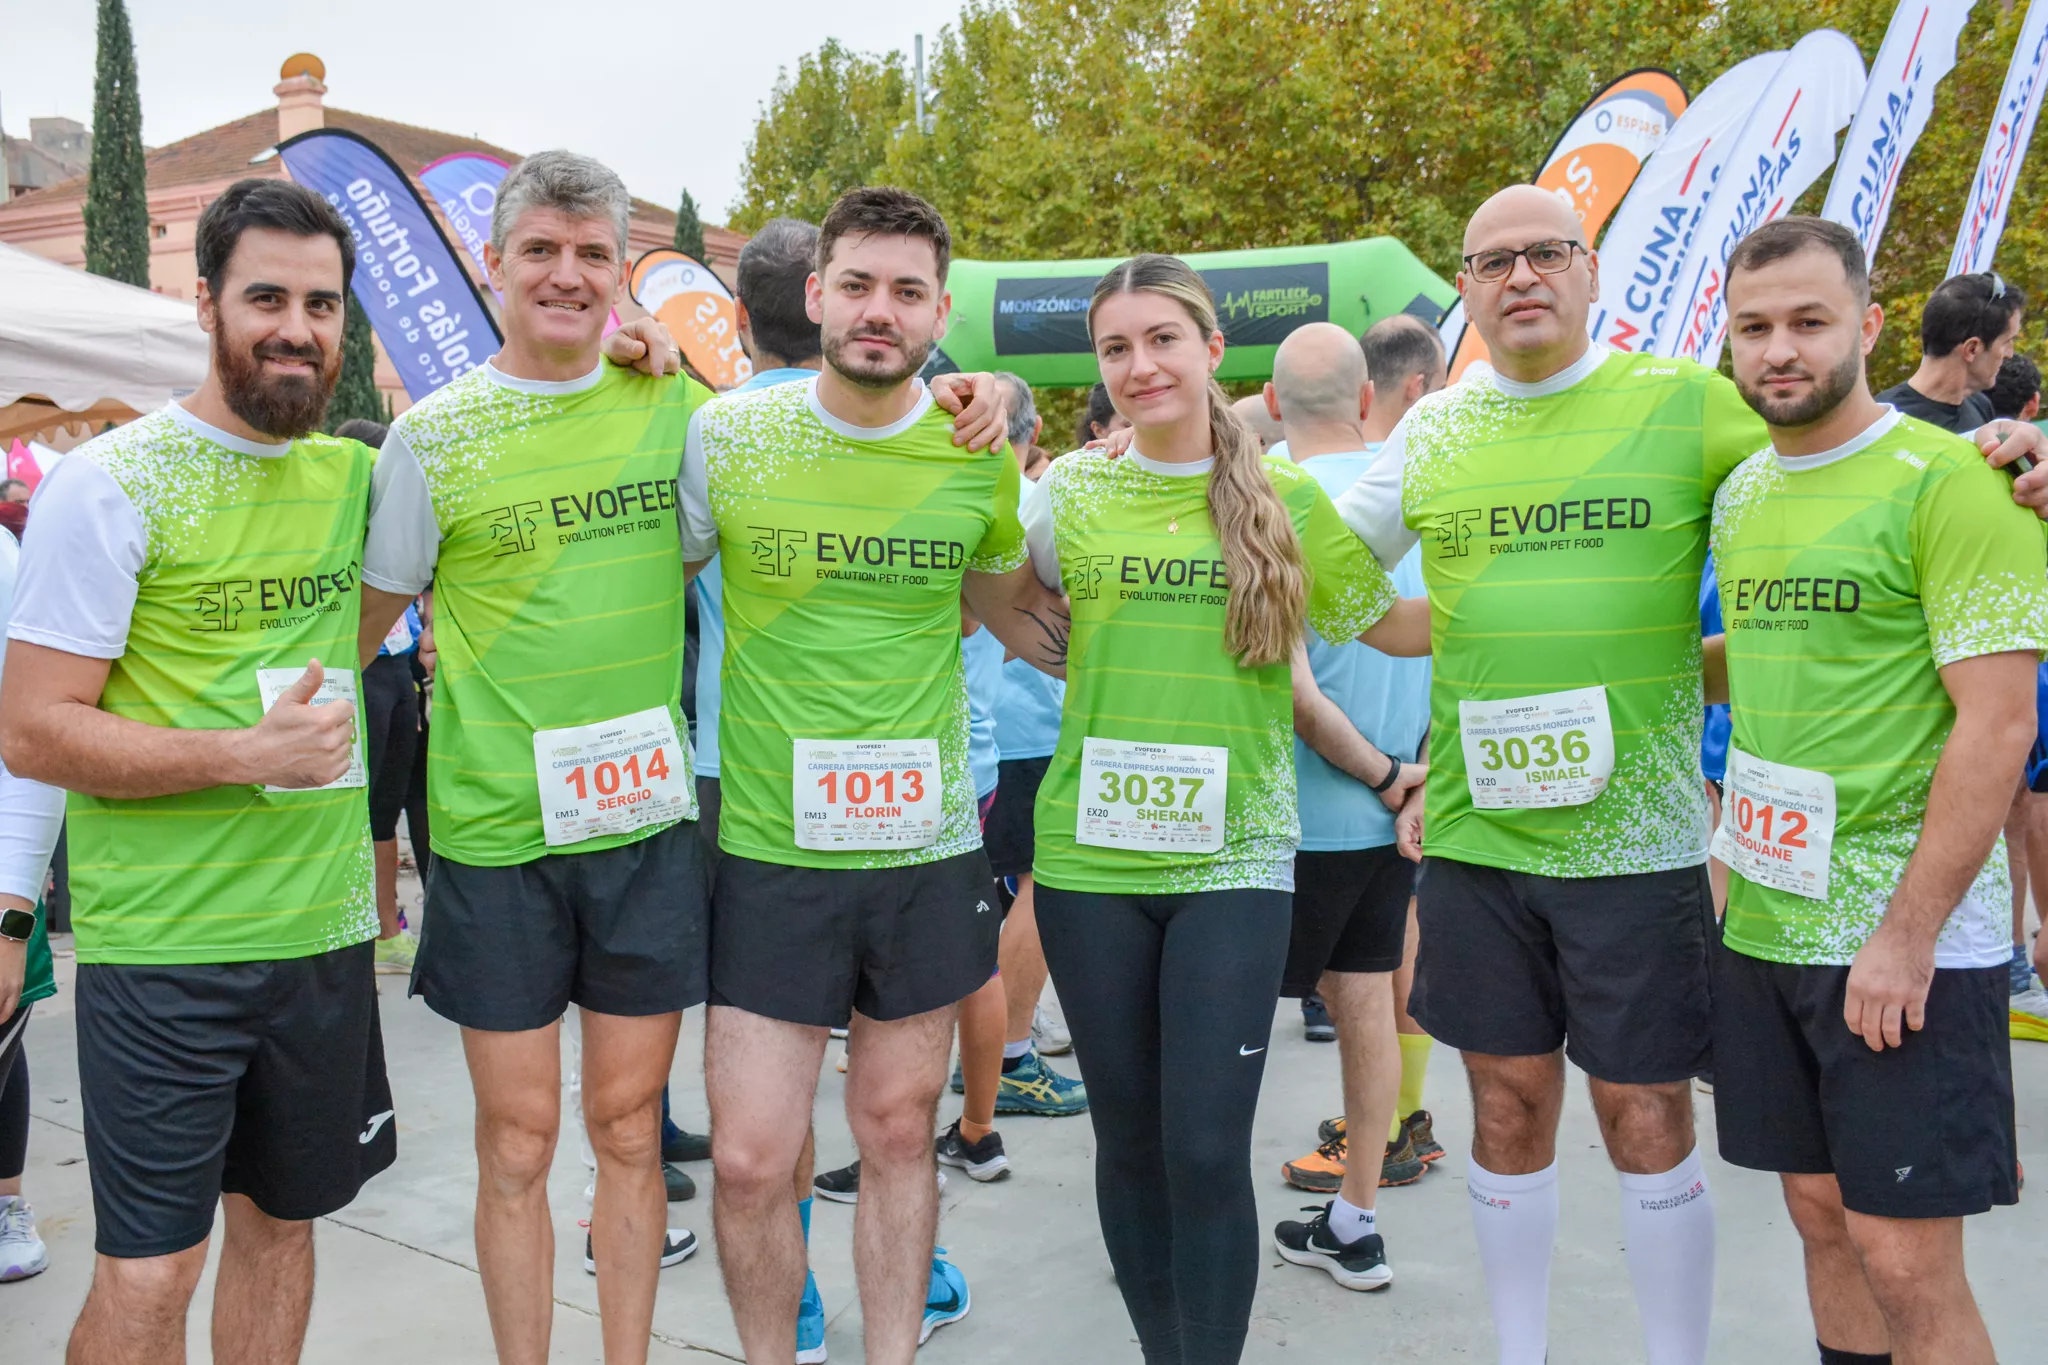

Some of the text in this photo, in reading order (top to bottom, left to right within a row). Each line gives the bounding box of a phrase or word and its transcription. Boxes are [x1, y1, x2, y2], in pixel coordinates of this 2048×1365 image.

[1721, 154, 1771, 267] CUNA
[1625, 206, 1688, 313] CUNA
[1252, 287, 1310, 301] FARTLECK
[1254, 303, 1308, 318] SPORT
[1490, 497, 1651, 537] EVOFEED
[559, 519, 661, 545] EVOLUTION PET FOOD
[817, 532, 964, 570] EVOFEED
[1490, 537, 1604, 555] EVOLUTION PET FOOD
[817, 569, 928, 585] EVOLUTION PET FOOD
[1120, 590, 1227, 606] EVOLUTION PET FOOD
[1736, 577, 1860, 613] EVOFEED
[1787, 619, 1809, 630] FOOD
[1505, 706, 1534, 715] EVOFEED
[1467, 716, 1595, 736] CARRERA EMPRESAS MONZÓN CM
[552, 755, 591, 769] CARRERA
[593, 748, 632, 763] EMPRESAS
[633, 739, 660, 753] MONZÓN
[661, 737, 671, 746] CM
[1479, 730, 1591, 771] 3036
[565, 747, 670, 800] 1014
[808, 763, 845, 771] CARRERA
[890, 761, 921, 770] MONZÓN
[1090, 759, 1215, 775] CARRERA EMPRESAS MONZÓN CM
[1525, 765, 1591, 784] ISMAEL
[818, 770, 924, 805] 1013
[1098, 771, 1205, 809] 3037
[1476, 777, 1496, 787] EX20
[597, 789, 652, 811] SERGIO
[1771, 797, 1807, 812] MONZÓN
[1809, 806, 1823, 814] CM
[555, 809, 579, 819] EM13
[804, 812, 827, 820] EM13
[845, 806, 902, 818] FLORIN
[1087, 808, 1109, 818] EX20
[1136, 808, 1203, 823] SHERAN
[1730, 790, 1808, 849] 1012
[1359, 1214, 1375, 1223] PU
